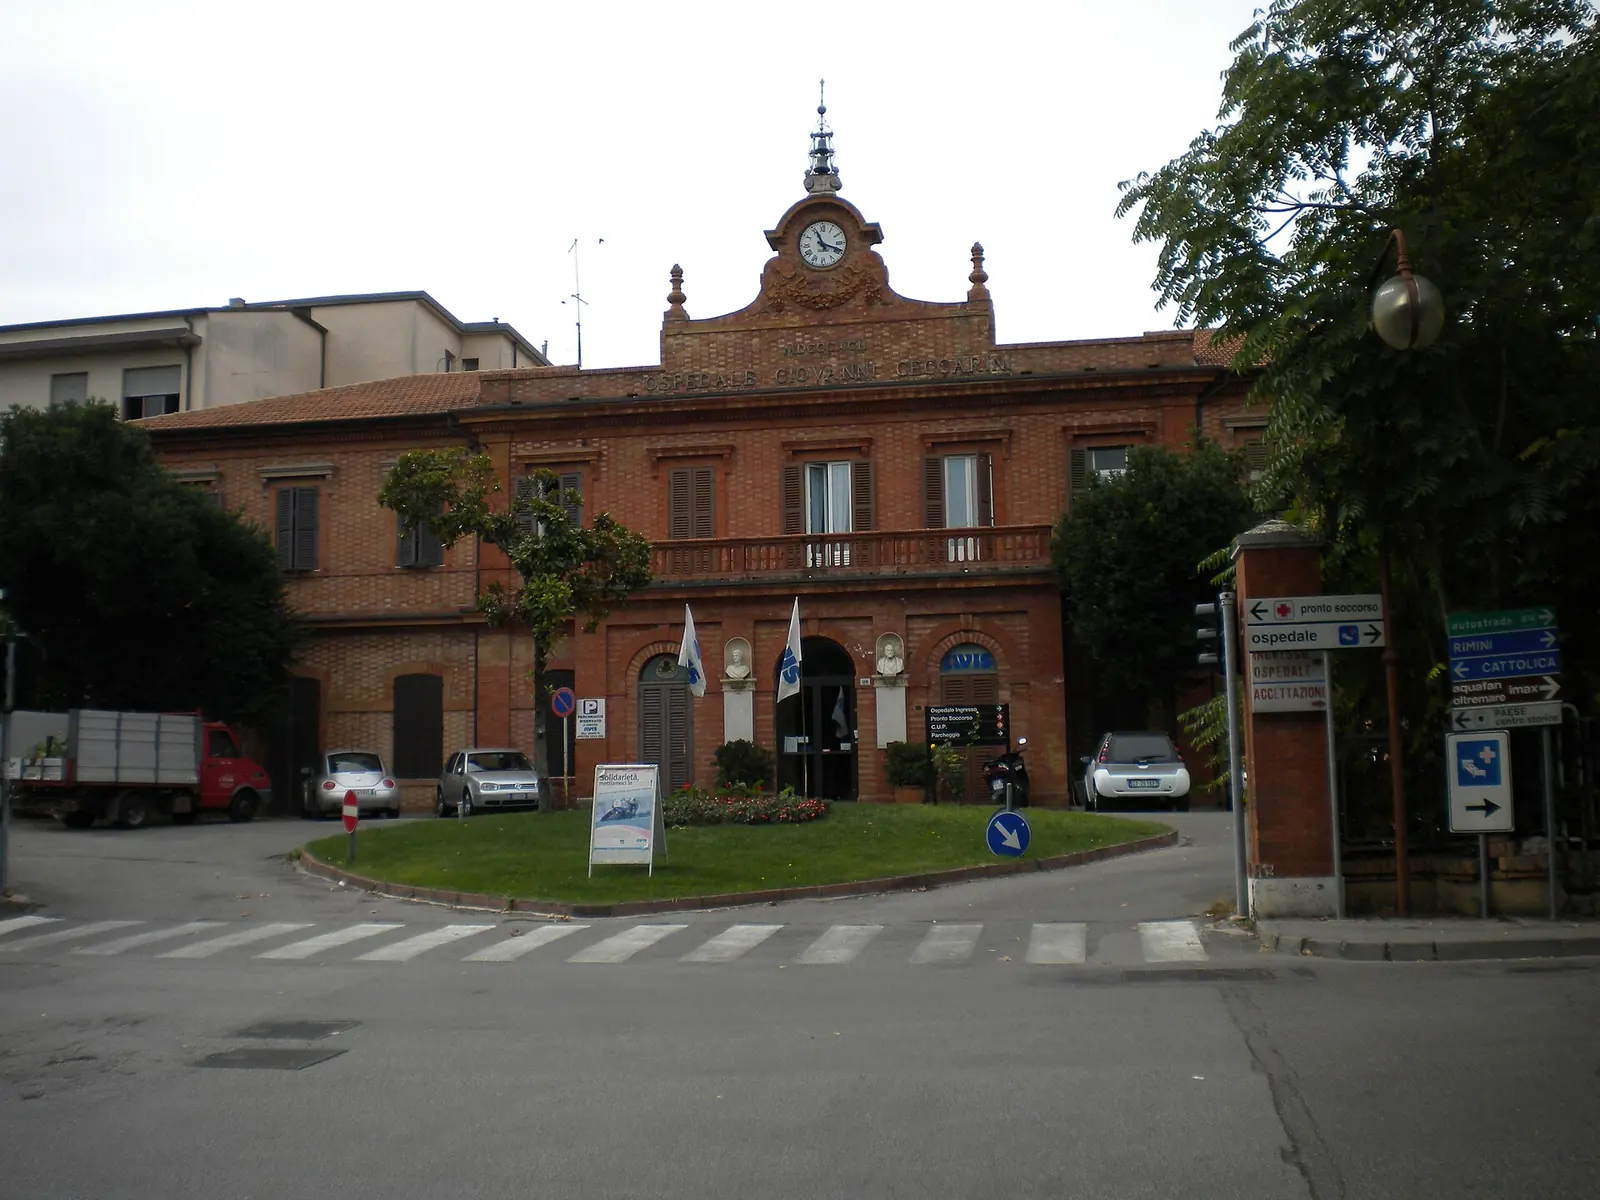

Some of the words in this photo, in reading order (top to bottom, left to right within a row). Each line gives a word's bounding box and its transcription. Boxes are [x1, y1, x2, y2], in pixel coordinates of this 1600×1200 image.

[645, 370, 757, 392] OSPEDALE
[775, 361, 877, 385] GIOVANNI
[896, 354, 1013, 377] CECCARINI
[1301, 603, 1332, 616] pronto
[1335, 603, 1378, 613] soccorso
[1252, 630, 1317, 646] ospedale
[1453, 640, 1492, 653] RIMINI
[1254, 664, 1312, 678] OSPEDALE
[1482, 657, 1556, 672] CATTOLICA
[1254, 686, 1327, 700] ACCETTAZIONE
[1453, 681, 1503, 694] aquafan
[1509, 684, 1539, 695] imax
[1453, 694, 1507, 706] oltremare
[1494, 707, 1526, 716] PAESE
[1495, 716, 1525, 726] centro
